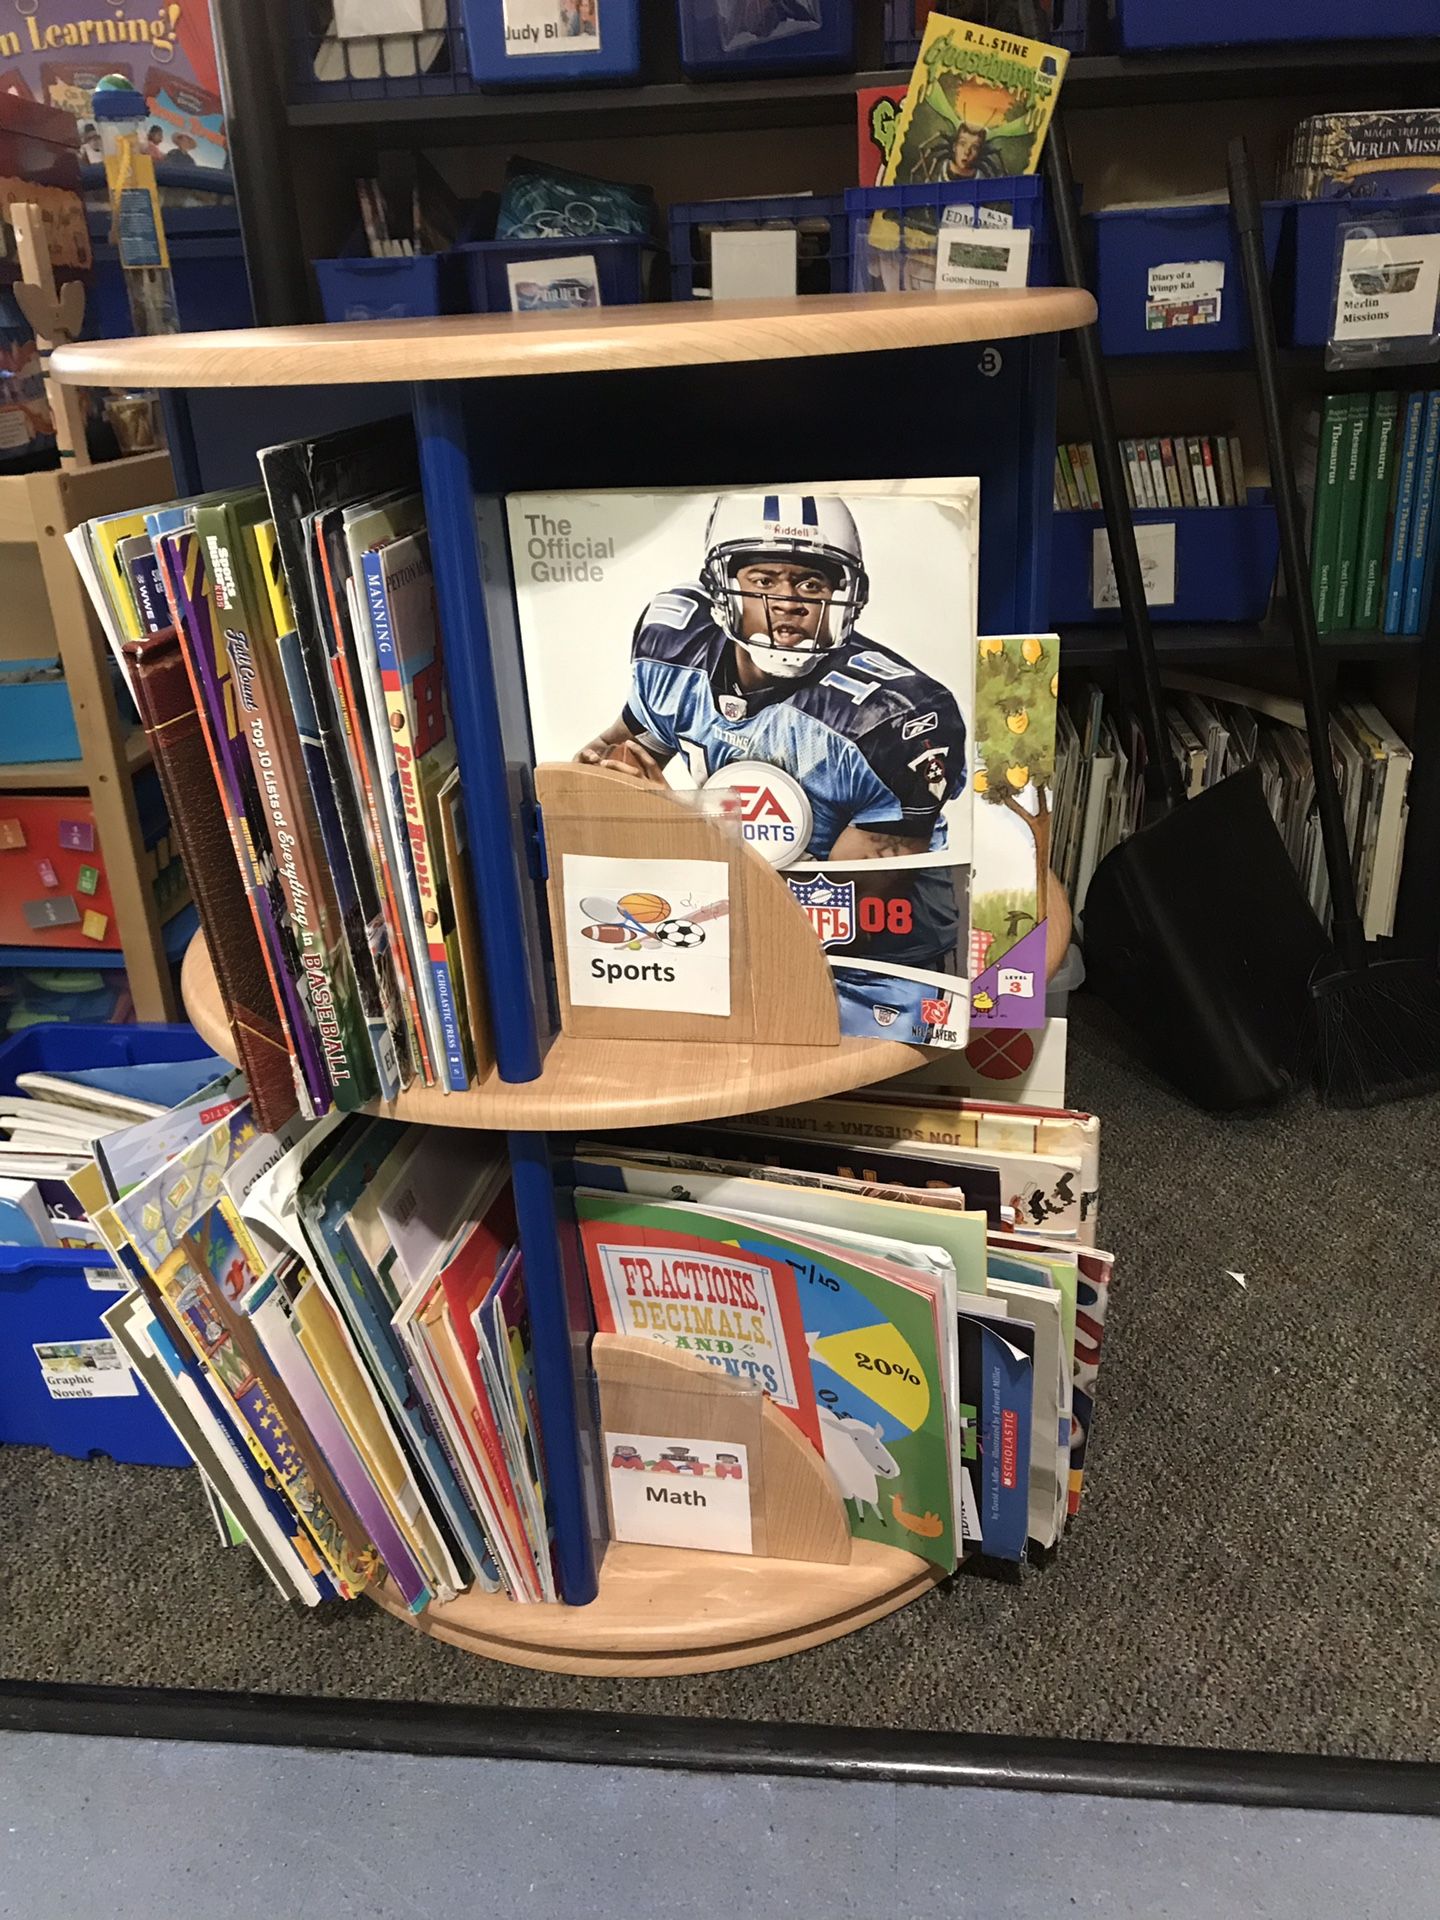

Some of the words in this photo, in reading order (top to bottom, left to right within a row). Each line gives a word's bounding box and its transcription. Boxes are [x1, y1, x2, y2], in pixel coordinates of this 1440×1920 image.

[25, 3, 181, 52] Learning!
[505, 24, 539, 43] Judy
[1347, 141, 1400, 158] MERLIN
[942, 273, 1000, 288] Goosebumps
[1150, 284, 1178, 292] Wimpy
[1180, 281, 1195, 289] Kid
[1152, 273, 1174, 282] Diary
[1344, 298, 1379, 309] Merlin
[1343, 311, 1390, 324] Missions
[1328, 423, 1342, 485] Thesaurus
[1349, 420, 1363, 480] Thesaurus
[1377, 418, 1392, 480] Thesaurus
[524, 514, 572, 536] The
[774, 524, 809, 537] Riddell
[527, 537, 615, 559] Official
[217, 547, 237, 597] Sports
[531, 561, 604, 582] Guide
[139, 585, 155, 619] WWE
[214, 583, 225, 609] KIDS
[224, 627, 253, 668] Full
[241, 666, 259, 711] Count
[250, 718, 265, 748] Top
[258, 750, 272, 768] 10
[262, 770, 280, 809] Lists
[367, 574, 392, 653] MANNING
[394, 743, 419, 818] FAMILY
[407, 820, 432, 898] HUDDLE
[436, 969, 452, 1022] SCHOLASTIC
[445, 1022, 457, 1049] PRESS
[722, 785, 791, 823] EA
[271, 810, 287, 828] of
[743, 824, 795, 842] ORTS
[278, 831, 310, 928] Everything
[859, 896, 913, 935] 08
[301, 932, 314, 946] in
[591, 958, 675, 984] Sports
[1010, 982, 1021, 992] 3
[302, 952, 351, 1087] BASEBALL
[912, 1025, 924, 1037] NFL
[775, 1115, 818, 1132] LANE
[840, 1121, 925, 1140] SCIESZKA
[929, 1130, 961, 1146] JON
[618, 1257, 766, 1316] FRACTIONS,
[629, 1300, 773, 1349] DECIMALS,
[676, 1335, 734, 1354] AND
[854, 1352, 921, 1387] 20%
[992, 1366, 1000, 1388] Miller
[47, 1375, 94, 1389] Graphic
[53, 1386, 93, 1398] Novels
[992, 1389, 1000, 1414] Edward
[1004, 1411, 1014, 1476] SCHOLASTIC
[992, 1465, 1000, 1483] Adler
[646, 1486, 707, 1507] Math
[992, 1491, 1000, 1510] David
